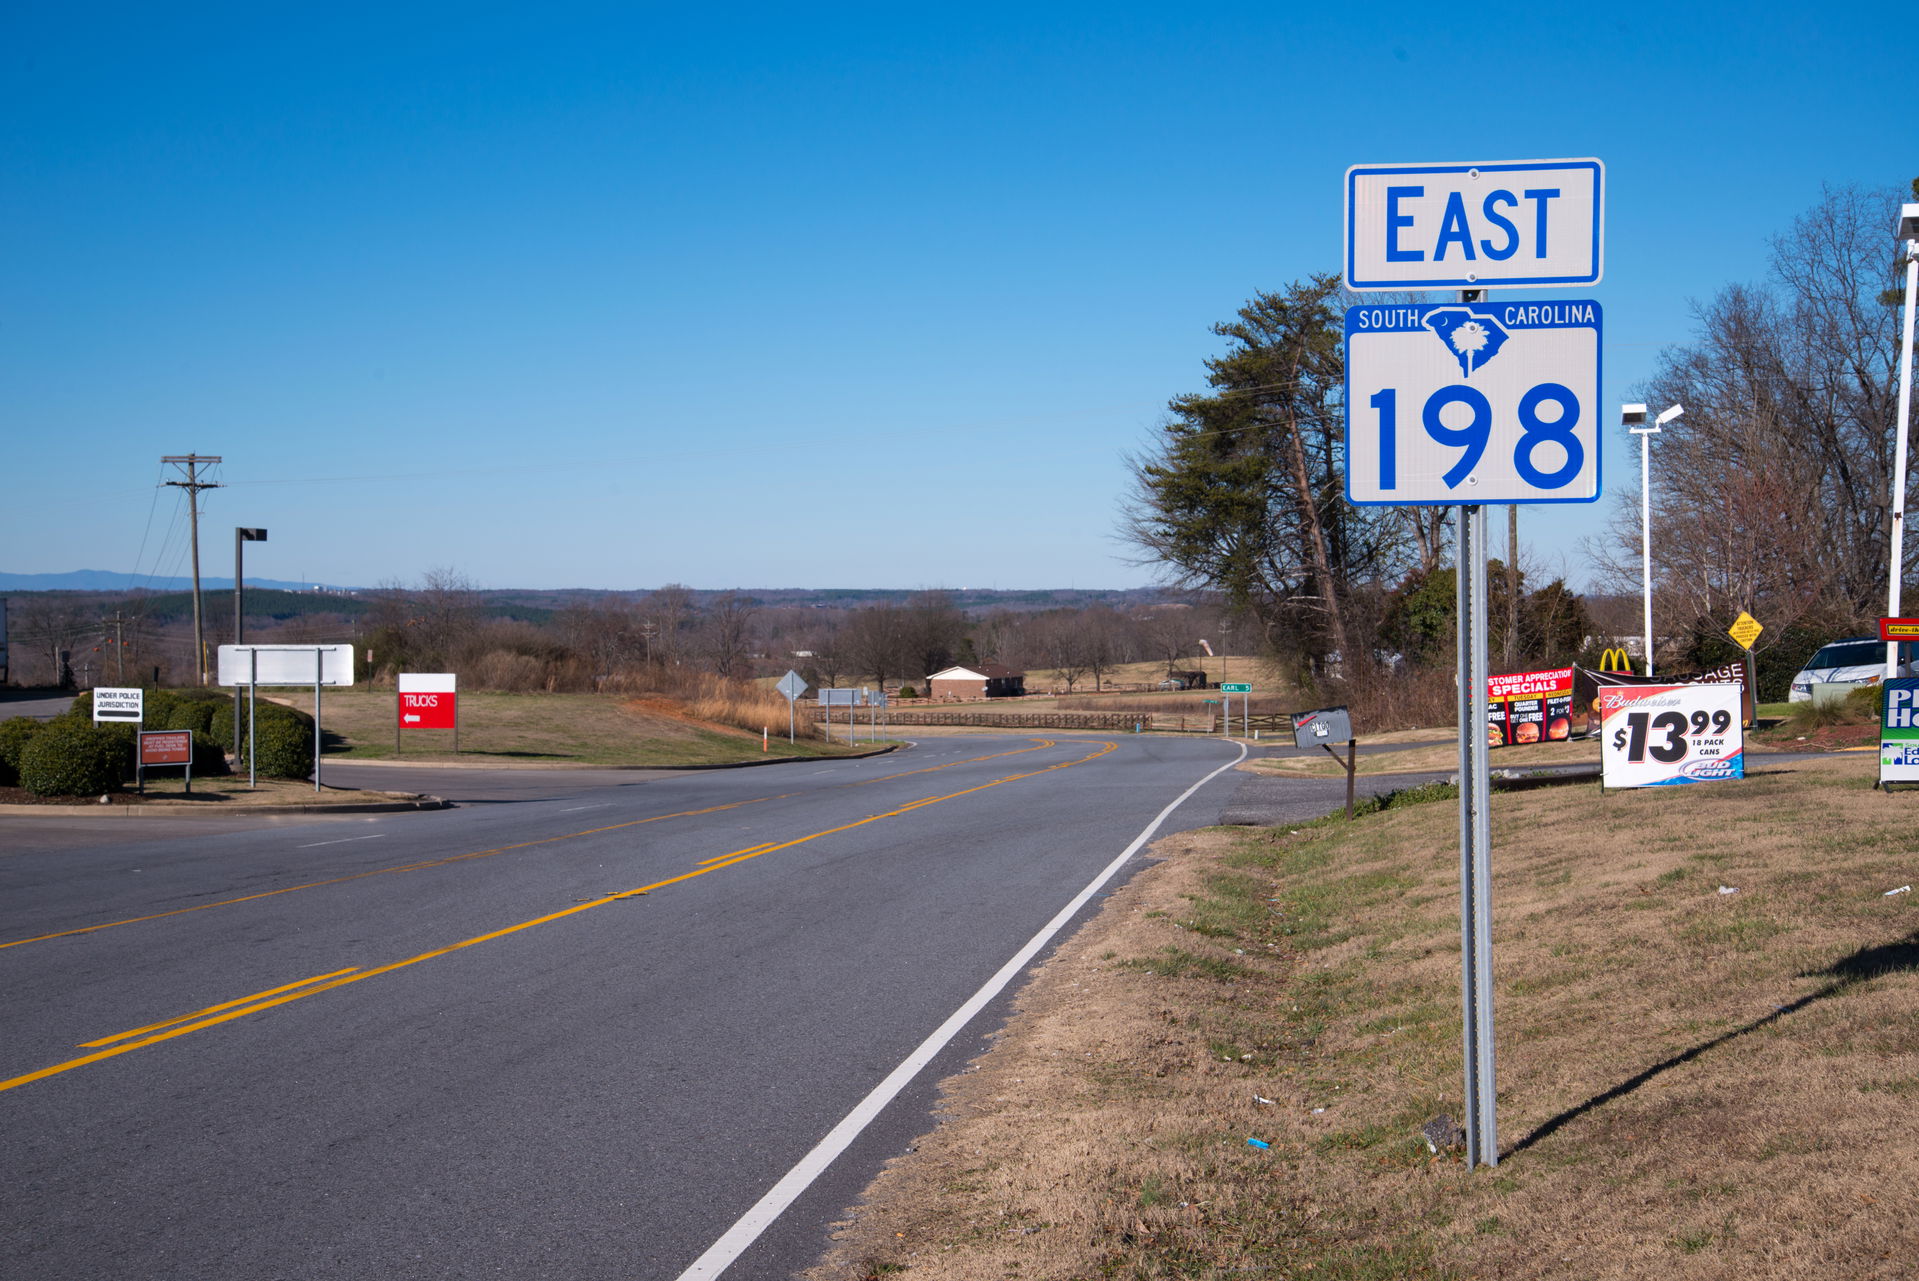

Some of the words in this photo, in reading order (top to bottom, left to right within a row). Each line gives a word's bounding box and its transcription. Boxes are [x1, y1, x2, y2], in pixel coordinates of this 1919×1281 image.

[1386, 186, 1560, 262] EAST
[1359, 309, 1419, 328] SOUTH
[1505, 305, 1595, 325] CAROLINA
[1370, 383, 1584, 491] 198
[1488, 675, 1524, 686] STOMER
[1492, 680, 1557, 695] SPECIALS
[97, 701, 139, 709] JURISDICTION
[403, 695, 438, 707] TRUCKS
[1488, 711, 1506, 721] FREE
[1528, 712, 1543, 722] FREE
[1694, 761, 1731, 769] BUD
[1690, 768, 1737, 778] LIGHT
